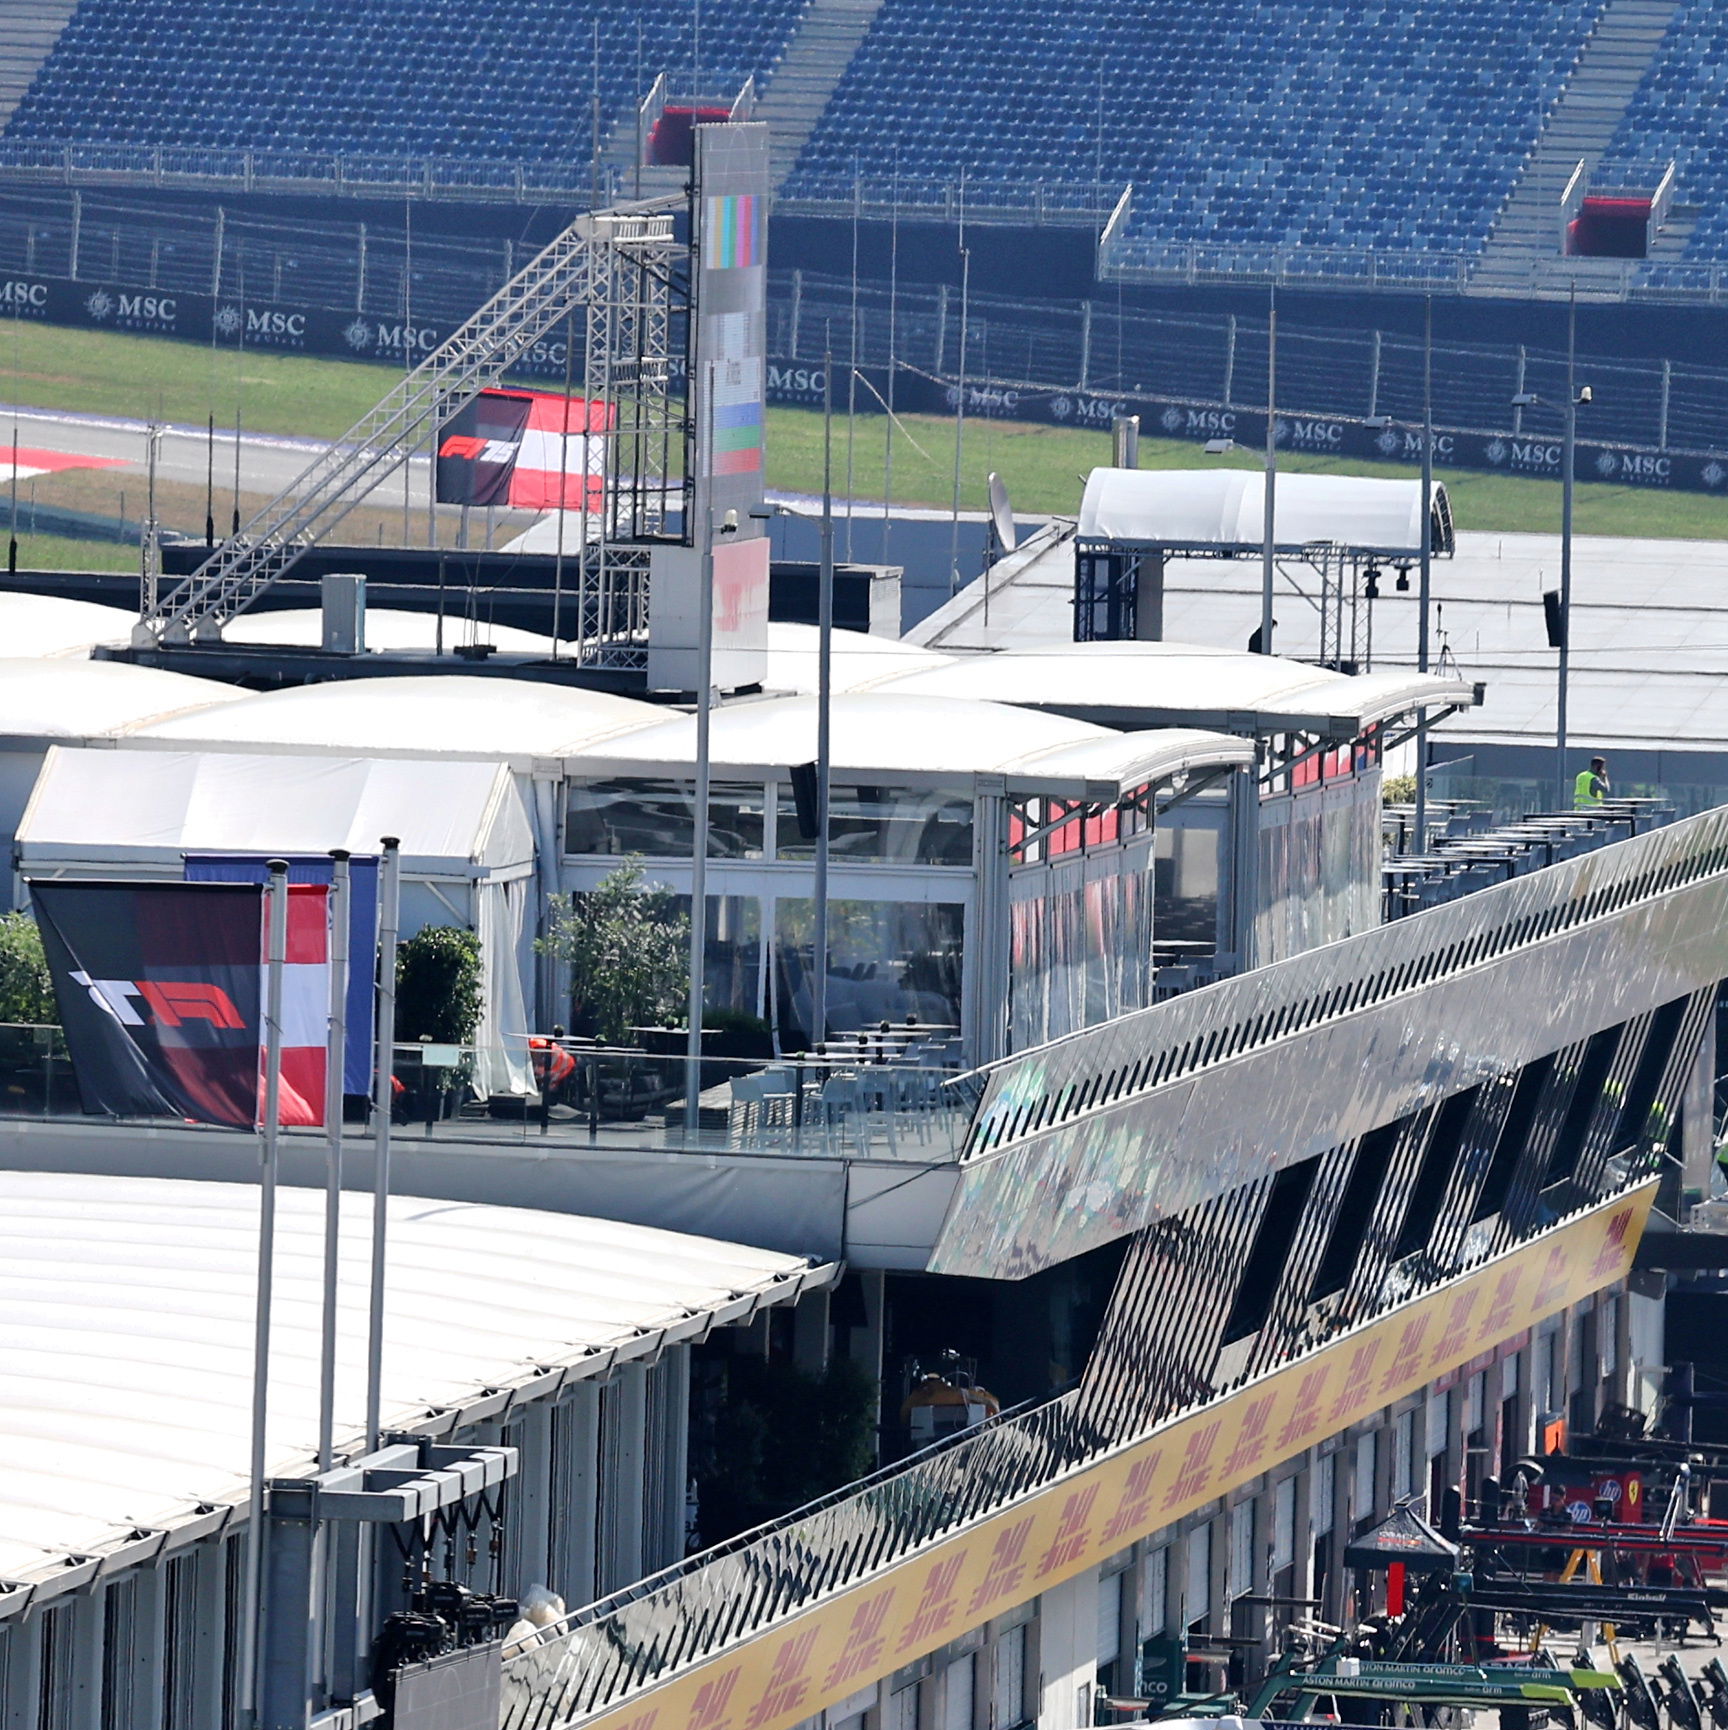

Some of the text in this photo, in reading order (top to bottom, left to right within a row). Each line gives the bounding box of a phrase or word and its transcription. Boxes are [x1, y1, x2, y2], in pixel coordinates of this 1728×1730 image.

[117, 294, 177, 320] MSC
[247, 309, 305, 335] MSC
[377, 323, 437, 351] MSC
[768, 366, 827, 392] MSC
[1186, 409, 1236, 430] MSC
[1294, 422, 1343, 442] MSC
[1511, 443, 1561, 463] MSC
[1622, 455, 1671, 476] MSC
[1302, 1676, 1416, 1690] ASTON MARTIN aramco
